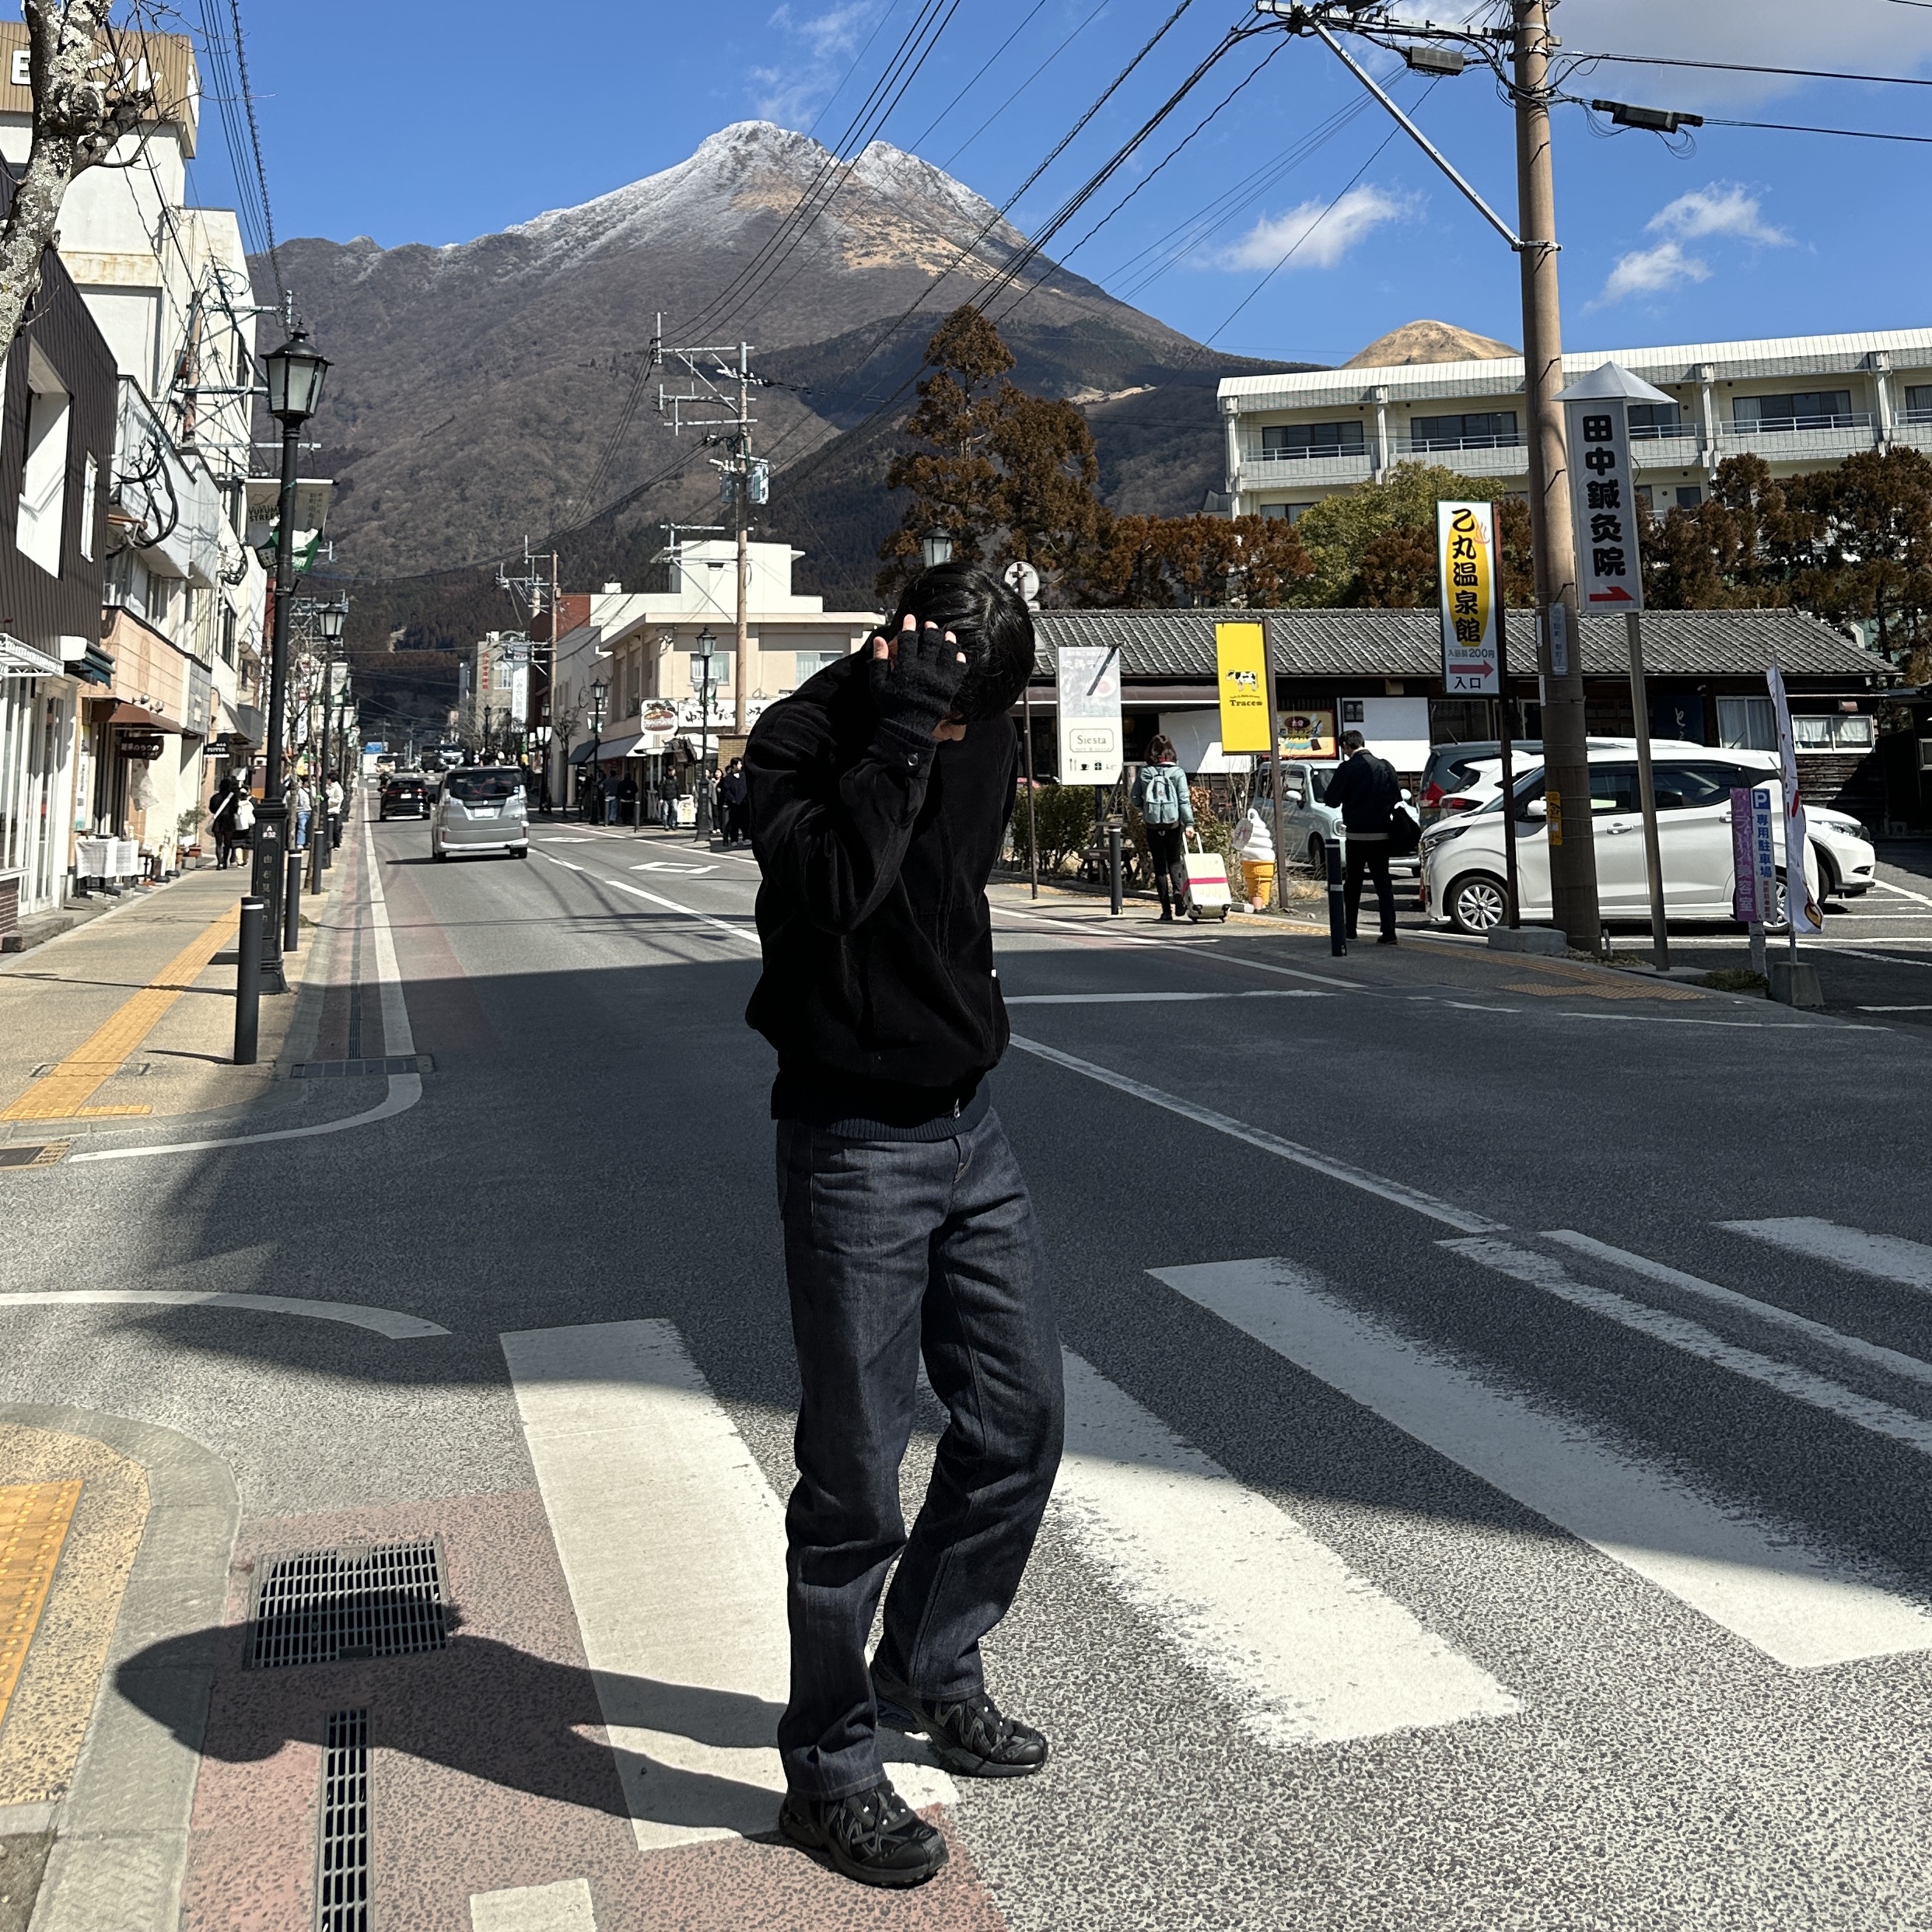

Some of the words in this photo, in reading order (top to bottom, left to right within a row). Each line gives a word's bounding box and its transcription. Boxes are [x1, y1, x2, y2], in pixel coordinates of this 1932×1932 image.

[1583, 415, 1626, 576] 田中鍼灸院
[1451, 508, 1481, 642] 乙丸温泉館
[1454, 677, 1481, 689] 入口
[1077, 734, 1106, 744] Siesta
[1755, 792, 1767, 808] P
[1756, 814, 1772, 878] 専用駐車場
